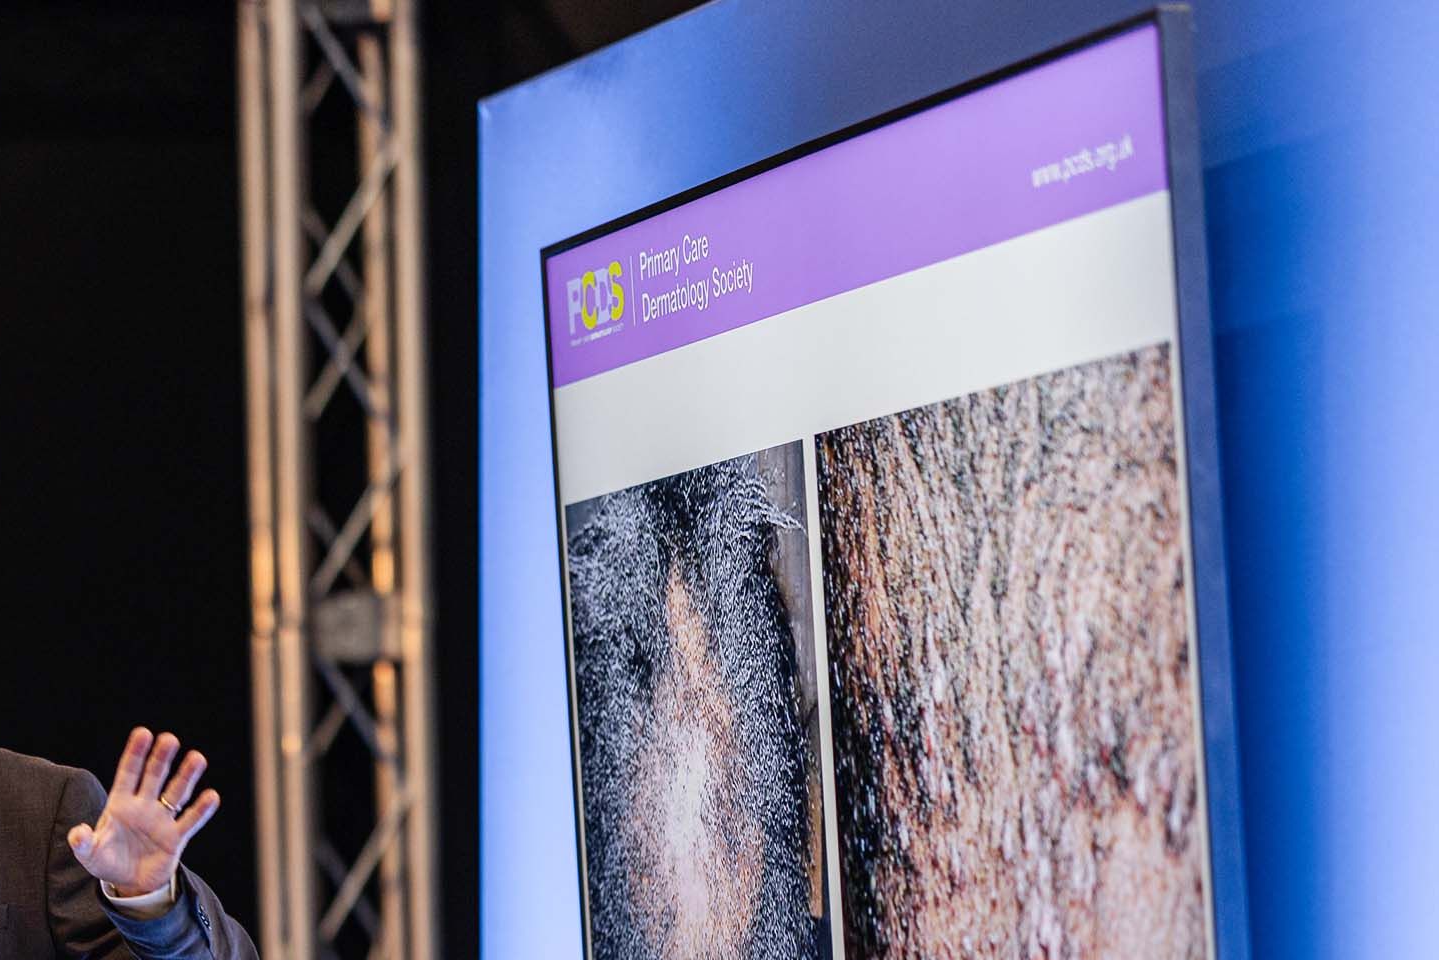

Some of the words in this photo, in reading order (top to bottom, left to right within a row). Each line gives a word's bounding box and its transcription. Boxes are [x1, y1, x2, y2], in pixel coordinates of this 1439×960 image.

[639, 246, 680, 281] Primary
[682, 234, 709, 265] Care
[566, 260, 625, 337] PCDS
[641, 277, 710, 323] Dermatology
[712, 259, 754, 298] Society
